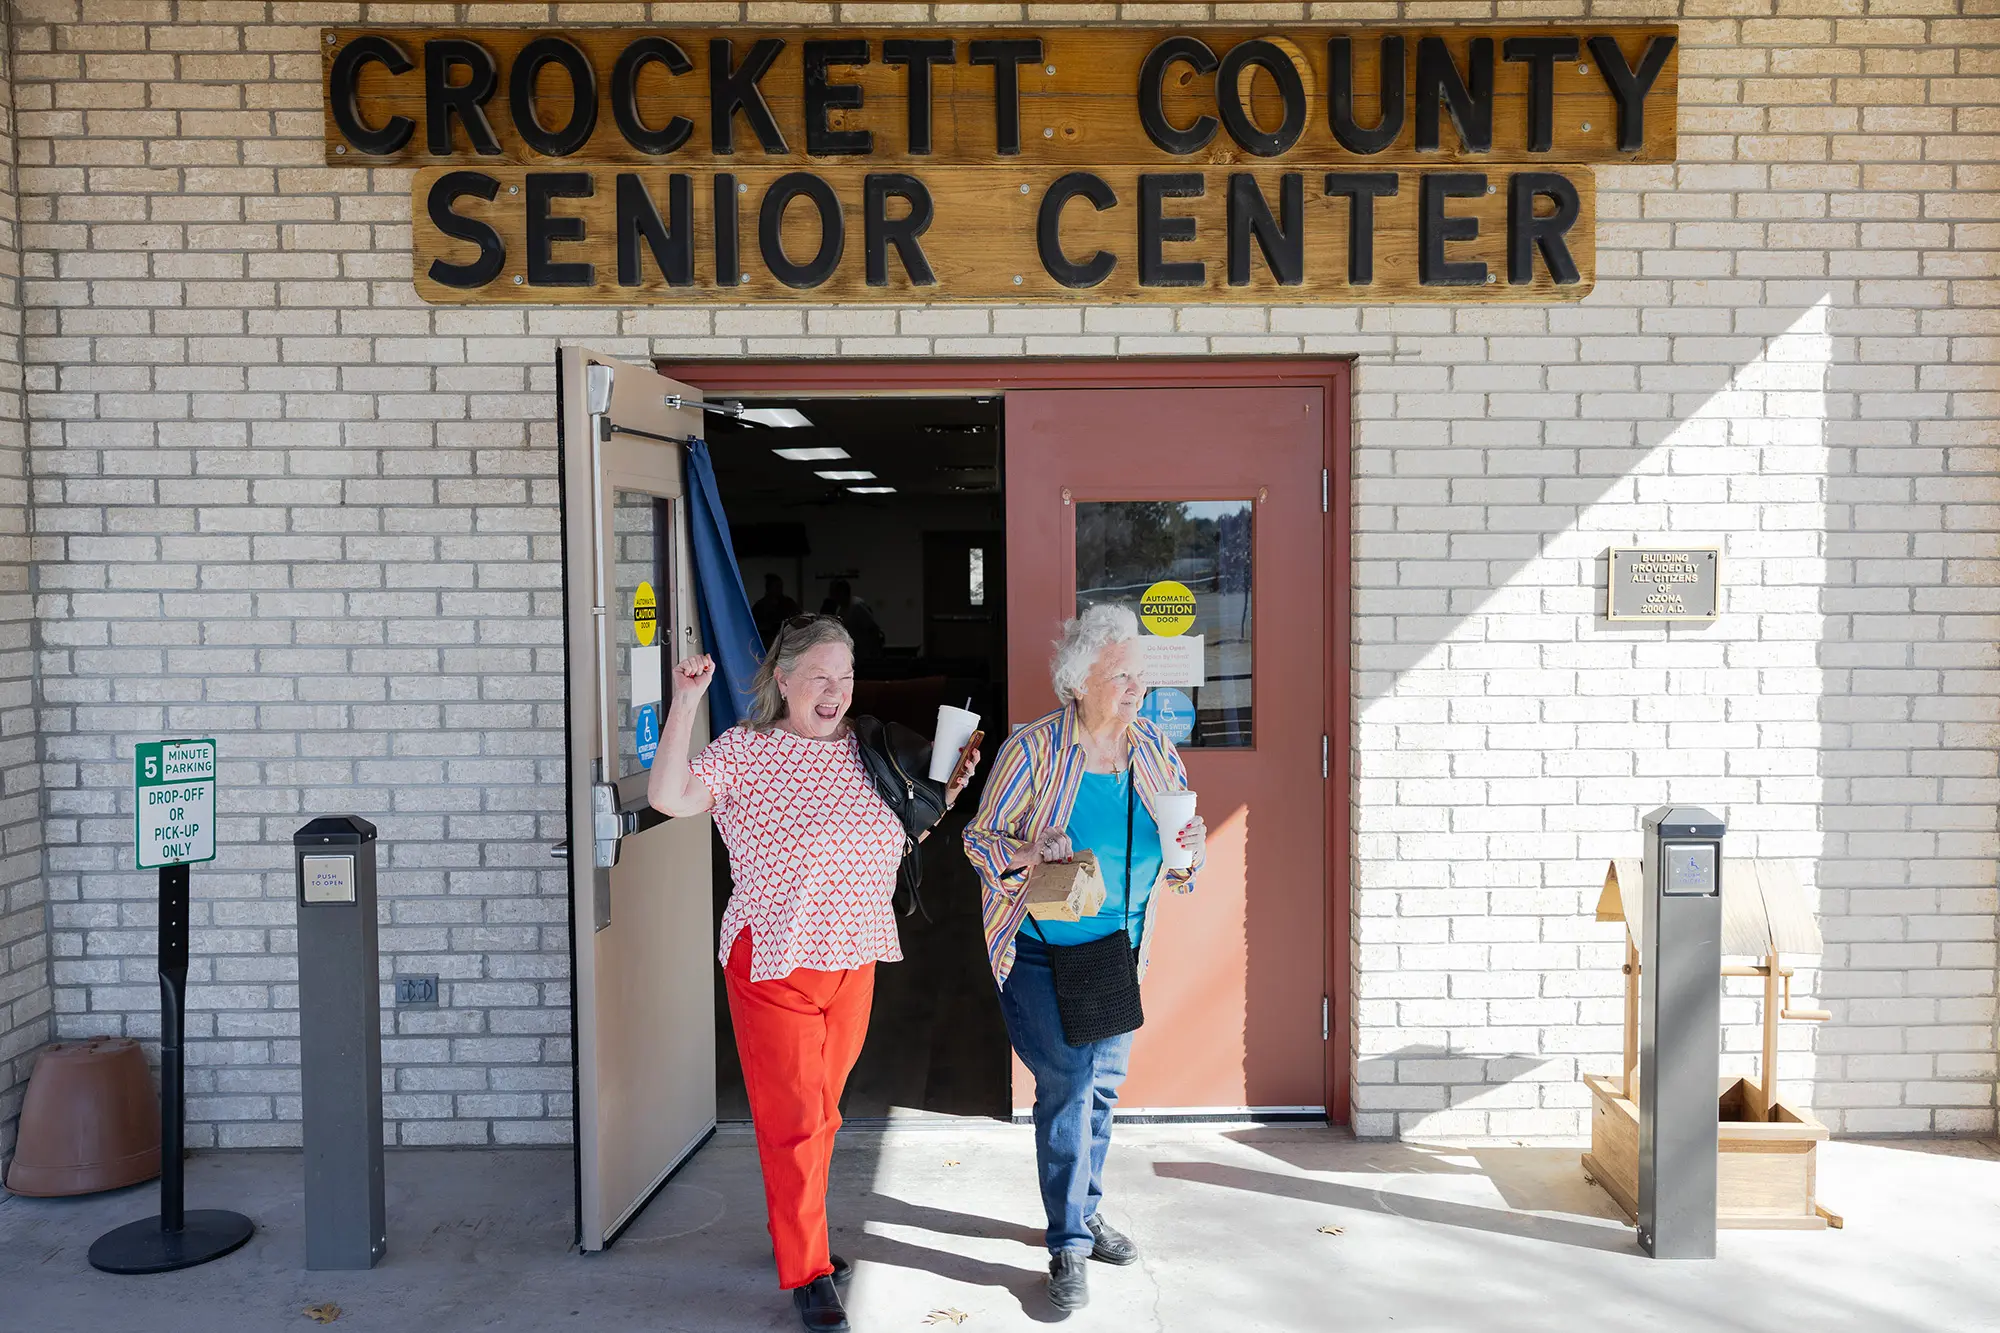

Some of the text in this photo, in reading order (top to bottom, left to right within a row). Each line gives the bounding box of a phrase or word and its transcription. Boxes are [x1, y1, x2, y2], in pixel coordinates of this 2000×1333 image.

[330, 35, 1678, 157] CROCKETT COUNTY
[427, 170, 1580, 289] SENIOR CENTER
[1641, 553, 1689, 563] BUILDING
[1631, 564, 1699, 573] PROVIDED BY
[1631, 574, 1698, 583] ALL CITIZENS
[1657, 584, 1672, 593] OF
[1646, 594, 1682, 603] OZONA
[1143, 604, 1193, 615] CAUTION
[1641, 604, 1687, 613] 2000 A.D.
[168, 748, 209, 761] MINUTE
[144, 756, 157, 779] 5
[165, 761, 212, 774] PARKING
[149, 787, 204, 805] DROP-OFF
[169, 807, 184, 821] OR
[154, 823, 199, 841] PICK-UP
[162, 842, 191, 858] ONLY
